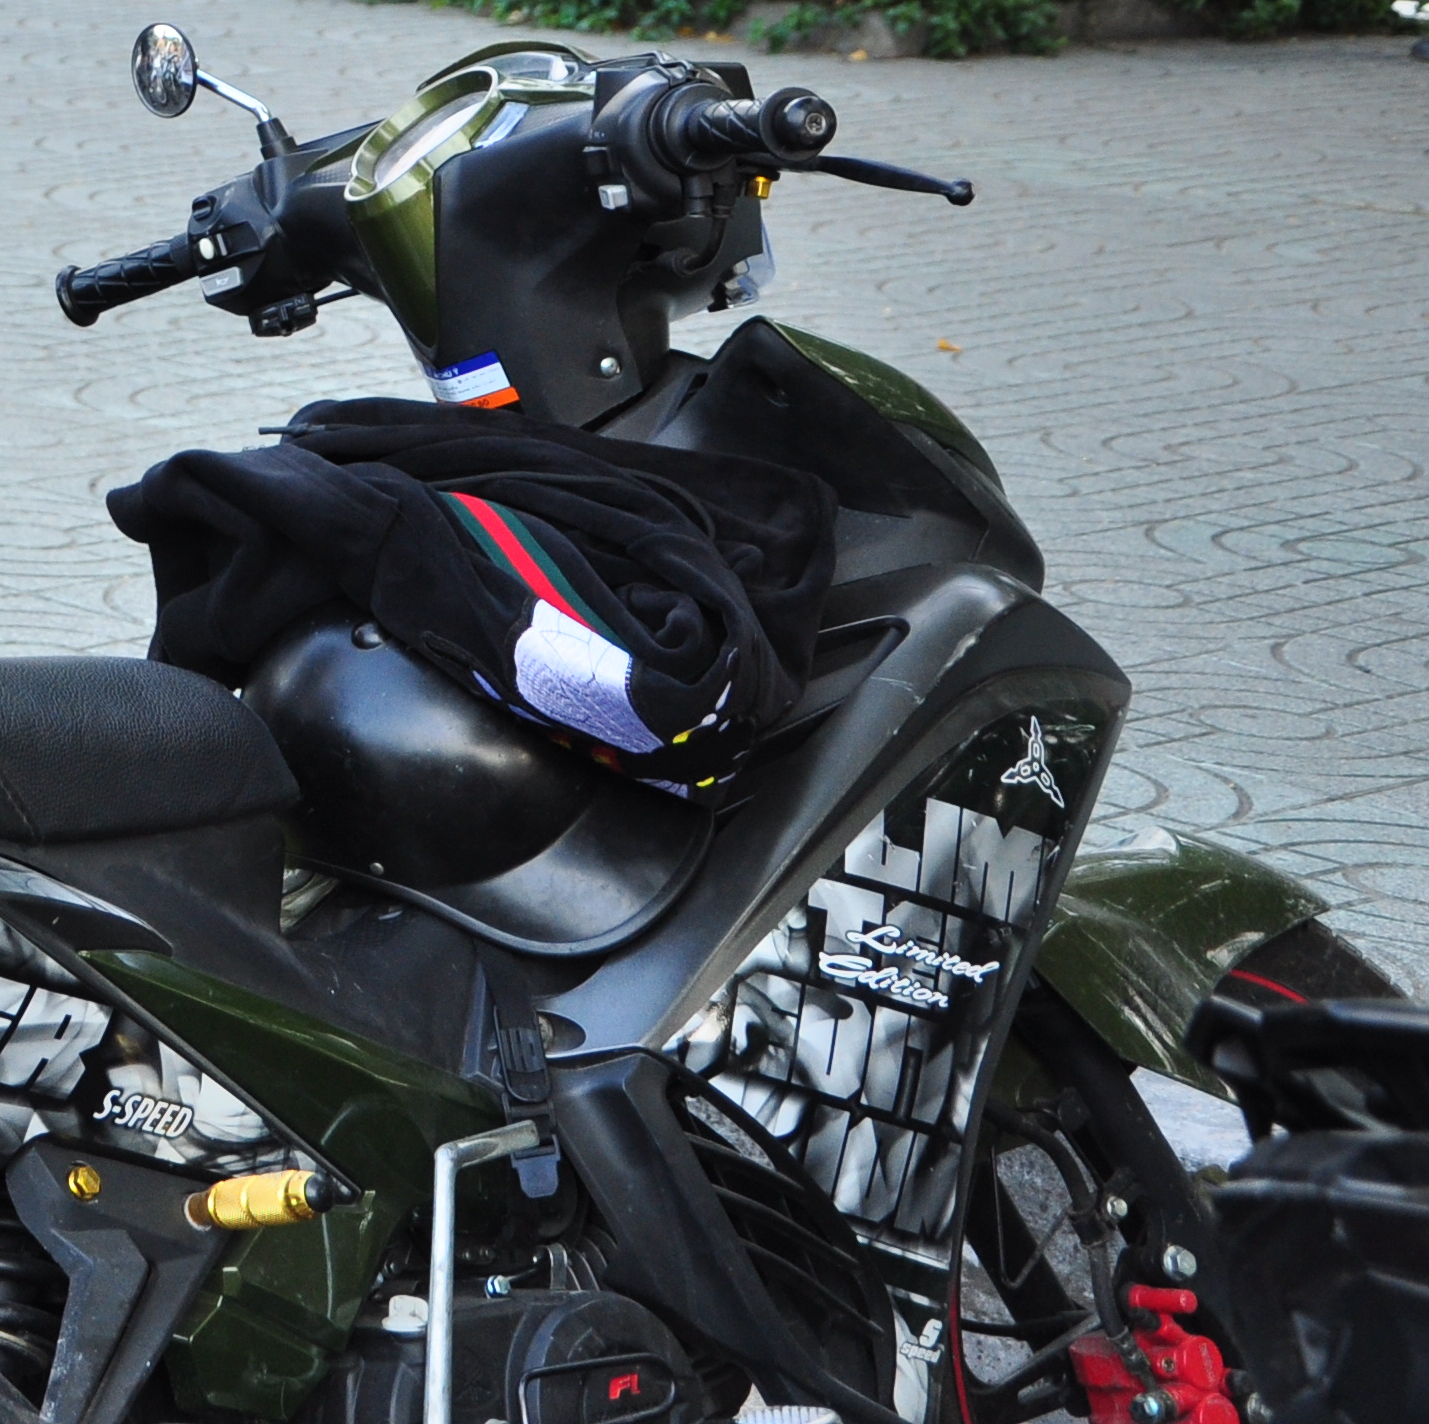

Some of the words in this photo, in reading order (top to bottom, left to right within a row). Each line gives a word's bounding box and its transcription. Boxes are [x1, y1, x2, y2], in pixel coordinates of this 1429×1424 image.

[818, 951, 950, 1009] Edition
[846, 925, 1001, 984] Limited
[92, 1089, 193, 1138] S-SPEED
